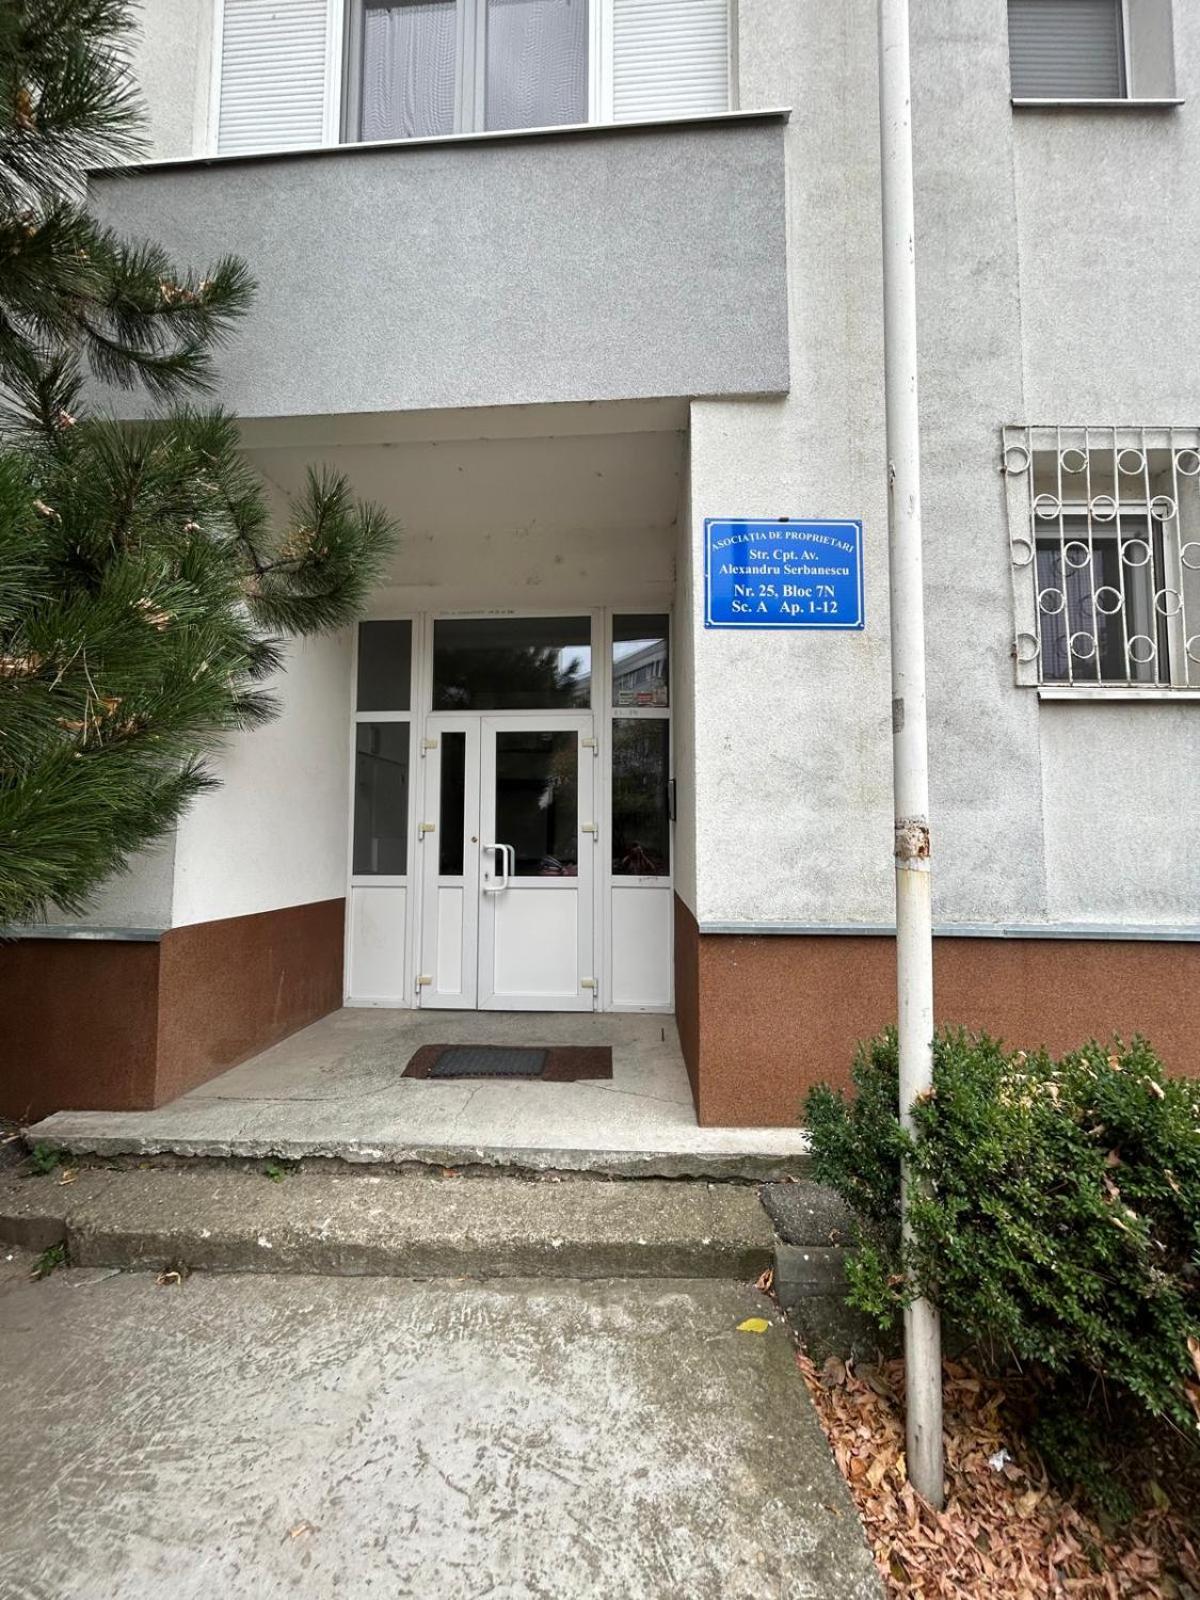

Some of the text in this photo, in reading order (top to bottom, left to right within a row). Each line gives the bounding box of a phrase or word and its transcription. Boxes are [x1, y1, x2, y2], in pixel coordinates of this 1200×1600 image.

[769, 531, 782, 539] DE
[785, 531, 854, 553] PROPRIETARI
[749, 549, 818, 562] Str. Cpt. Av.
[719, 564, 849, 575] Alexandru Serbanescu
[734, 585, 754, 596] Nr.
[783, 585, 812, 597] Bloc
[816, 586, 835, 597] 7N
[732, 601, 838, 615] Sc. A Ap. 1-12
